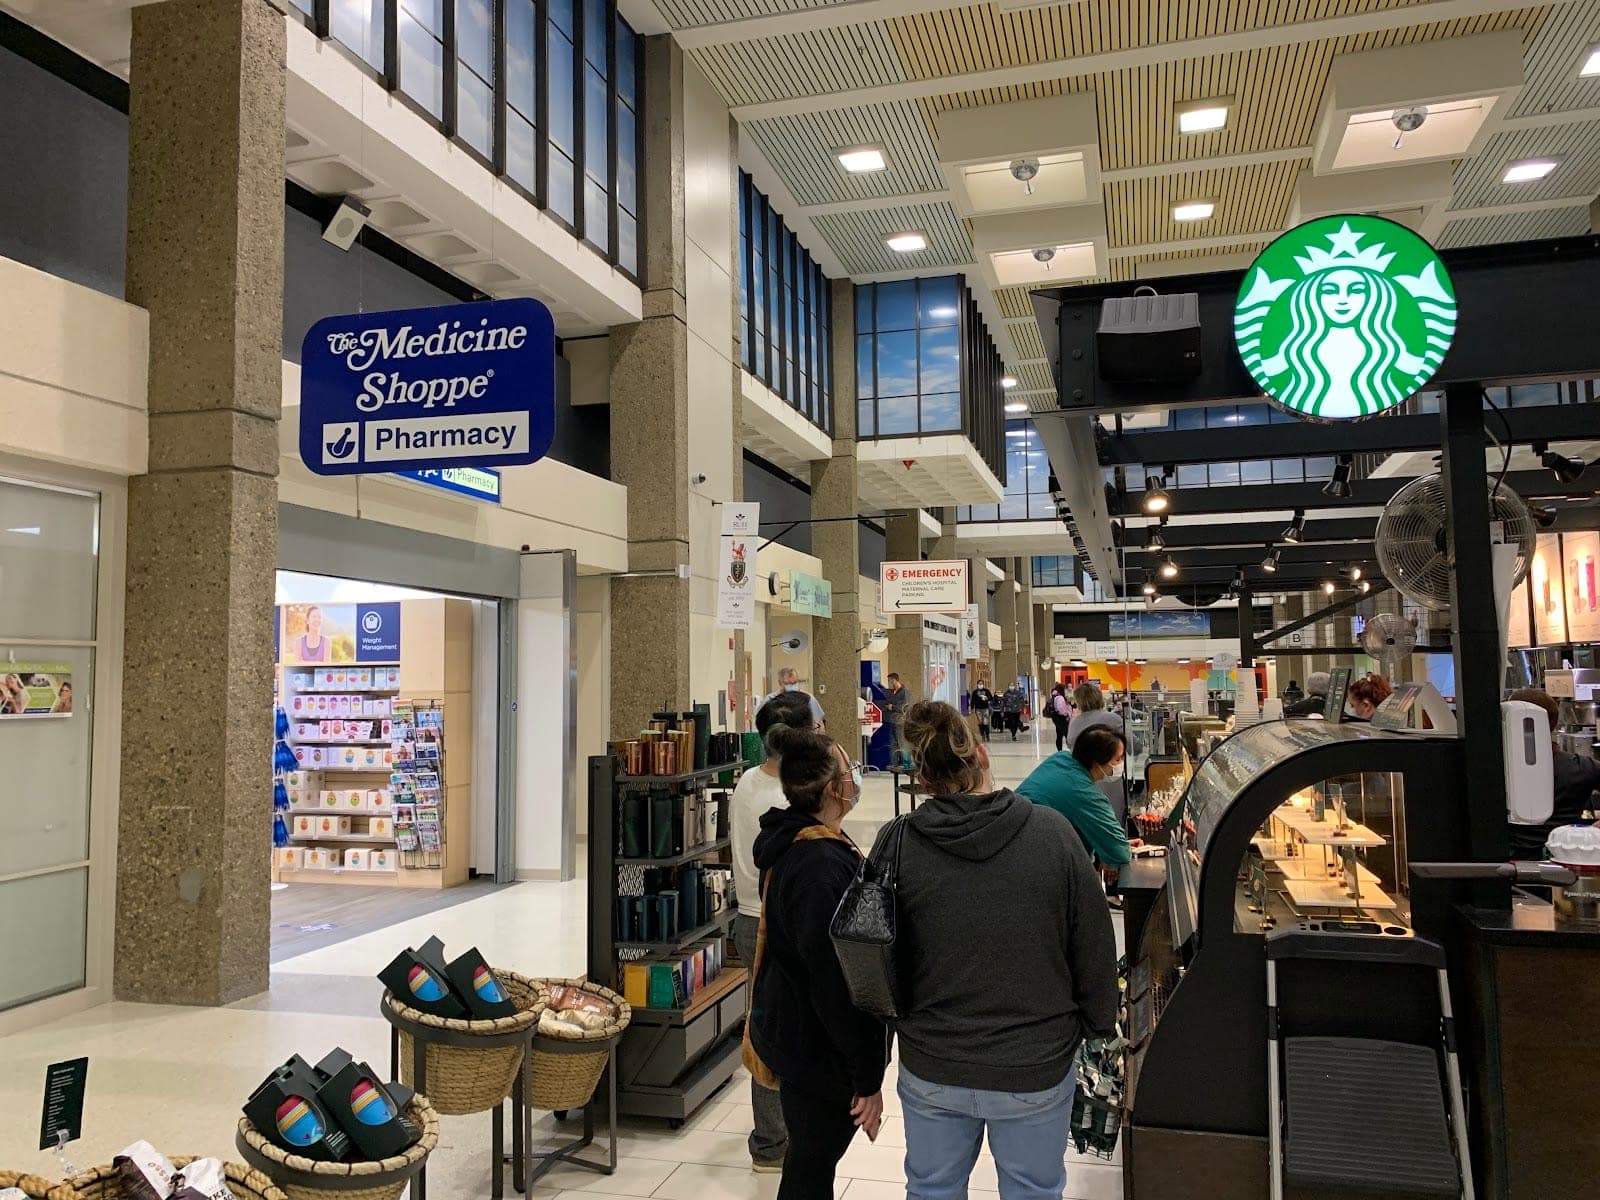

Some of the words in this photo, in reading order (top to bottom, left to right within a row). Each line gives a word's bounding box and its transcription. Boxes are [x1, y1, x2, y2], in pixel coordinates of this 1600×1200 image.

[327, 332, 358, 354] The
[347, 319, 527, 371] Medicine
[376, 425, 516, 450] Pharmacy
[456, 467, 495, 491] Pharmacy
[902, 568, 962, 578] EMERGENCY
[1293, 633, 1301, 643] B
